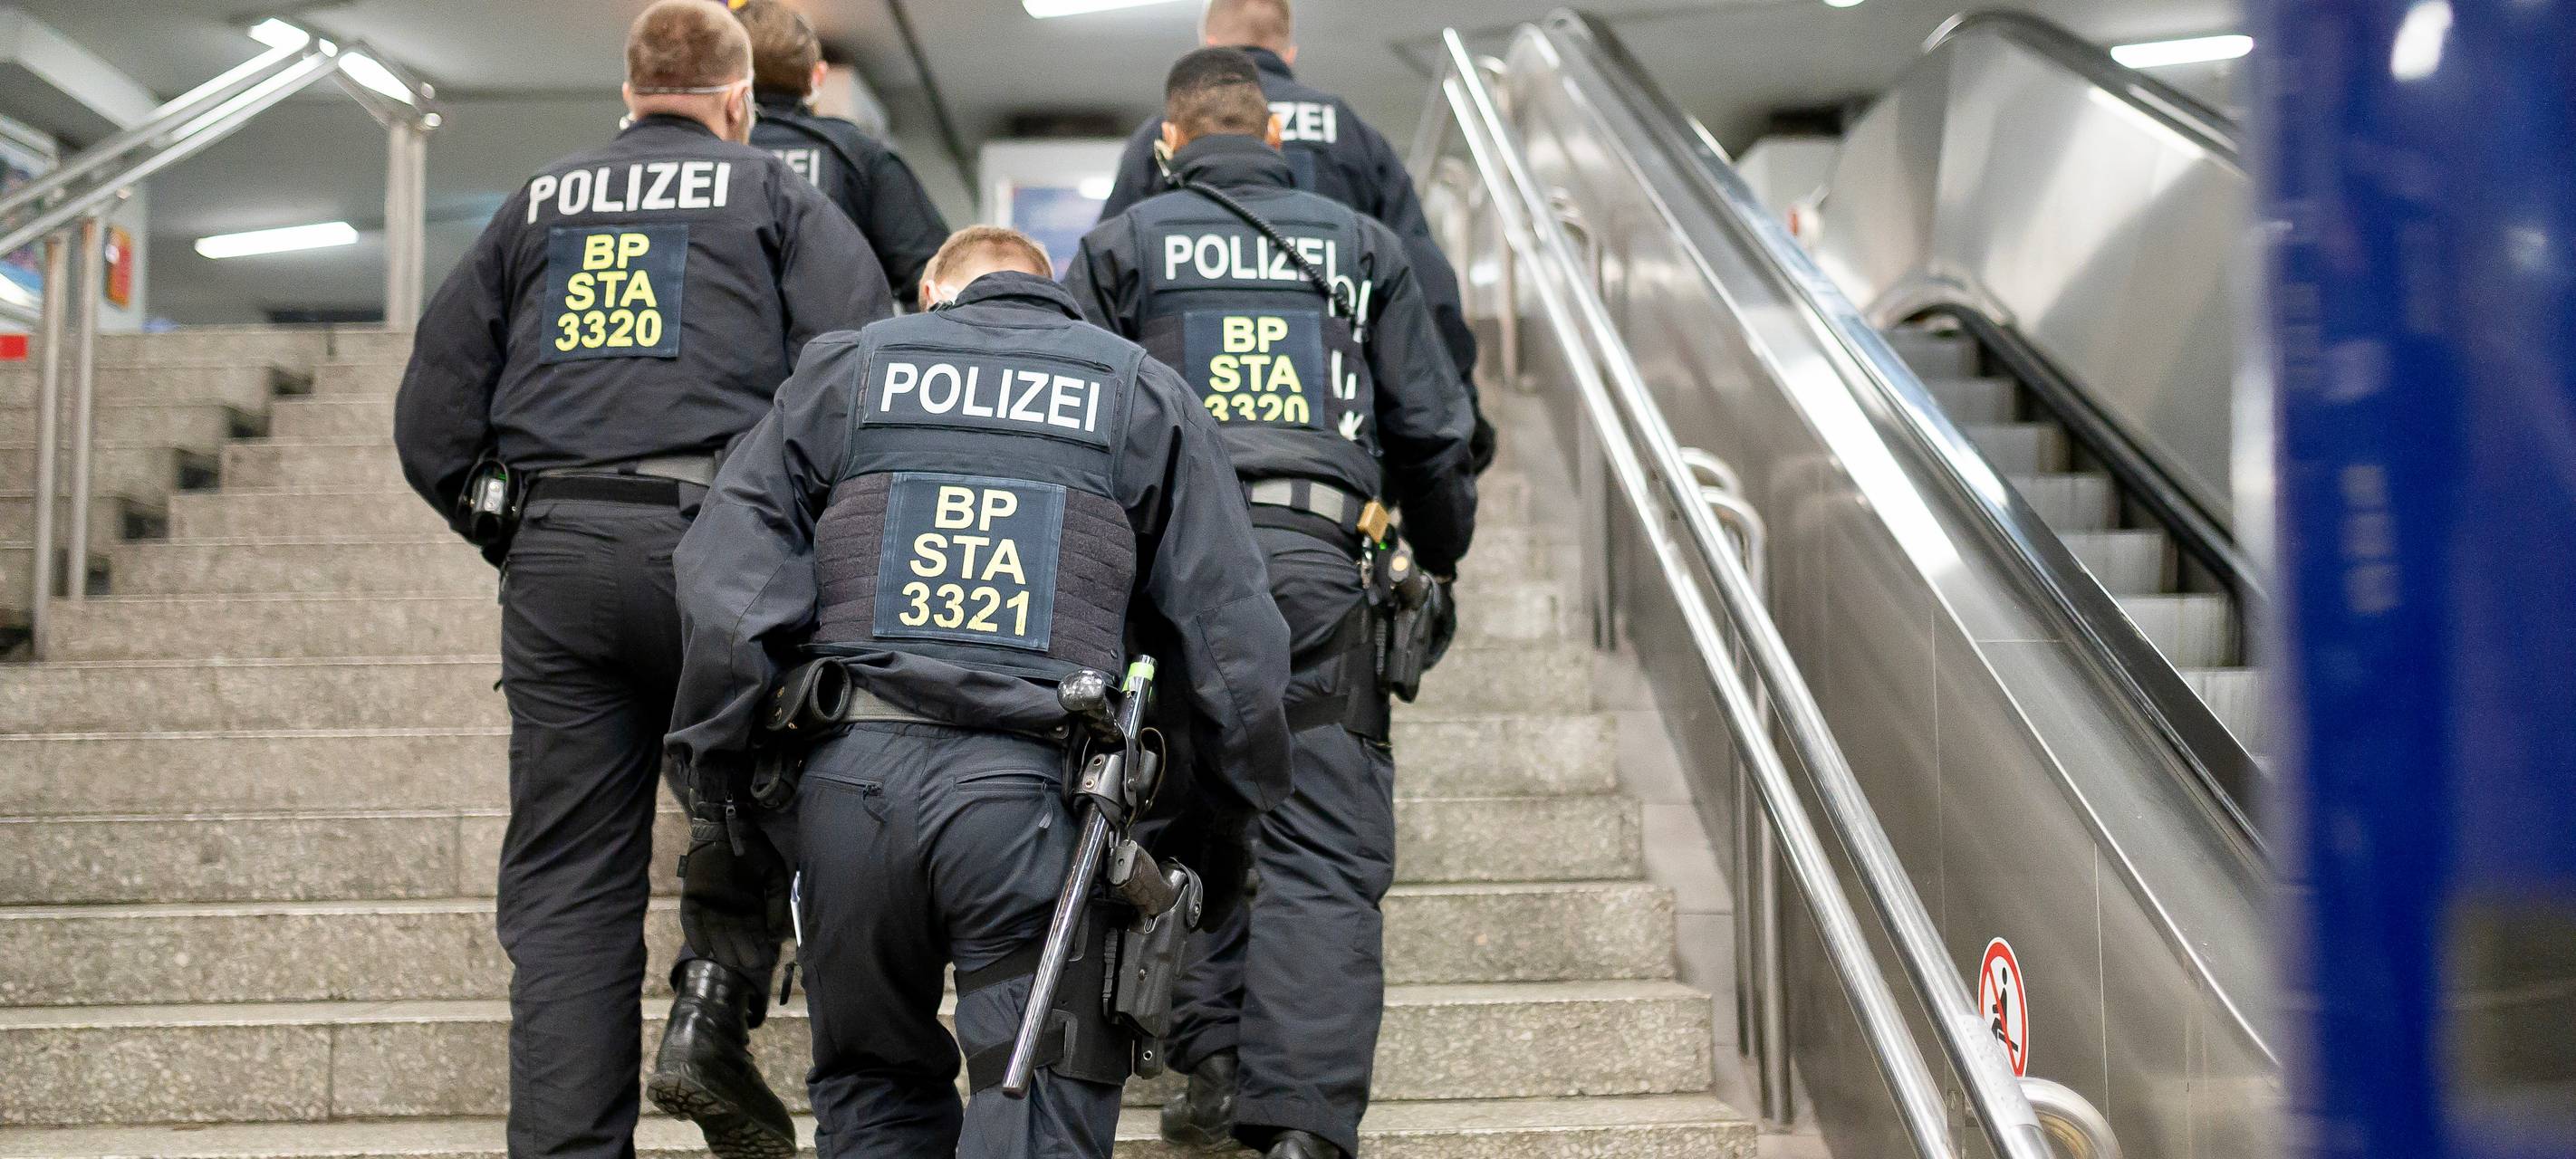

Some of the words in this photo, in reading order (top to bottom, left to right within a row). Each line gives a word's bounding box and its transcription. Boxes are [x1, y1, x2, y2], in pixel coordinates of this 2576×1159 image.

[527, 161, 731, 225] POLIZEI
[582, 234, 649, 270] BP
[1165, 234, 1338, 283] POLIZEI
[565, 270, 657, 311] STA
[554, 309, 662, 351] 3320
[1223, 316, 1289, 353] BP
[1208, 354, 1302, 393] STA
[879, 362, 1101, 433] POLIZEI
[1204, 393, 1310, 424] 3320
[934, 485, 1018, 532] BP
[909, 532, 1026, 585] STA
[899, 581, 1030, 637] 3321
